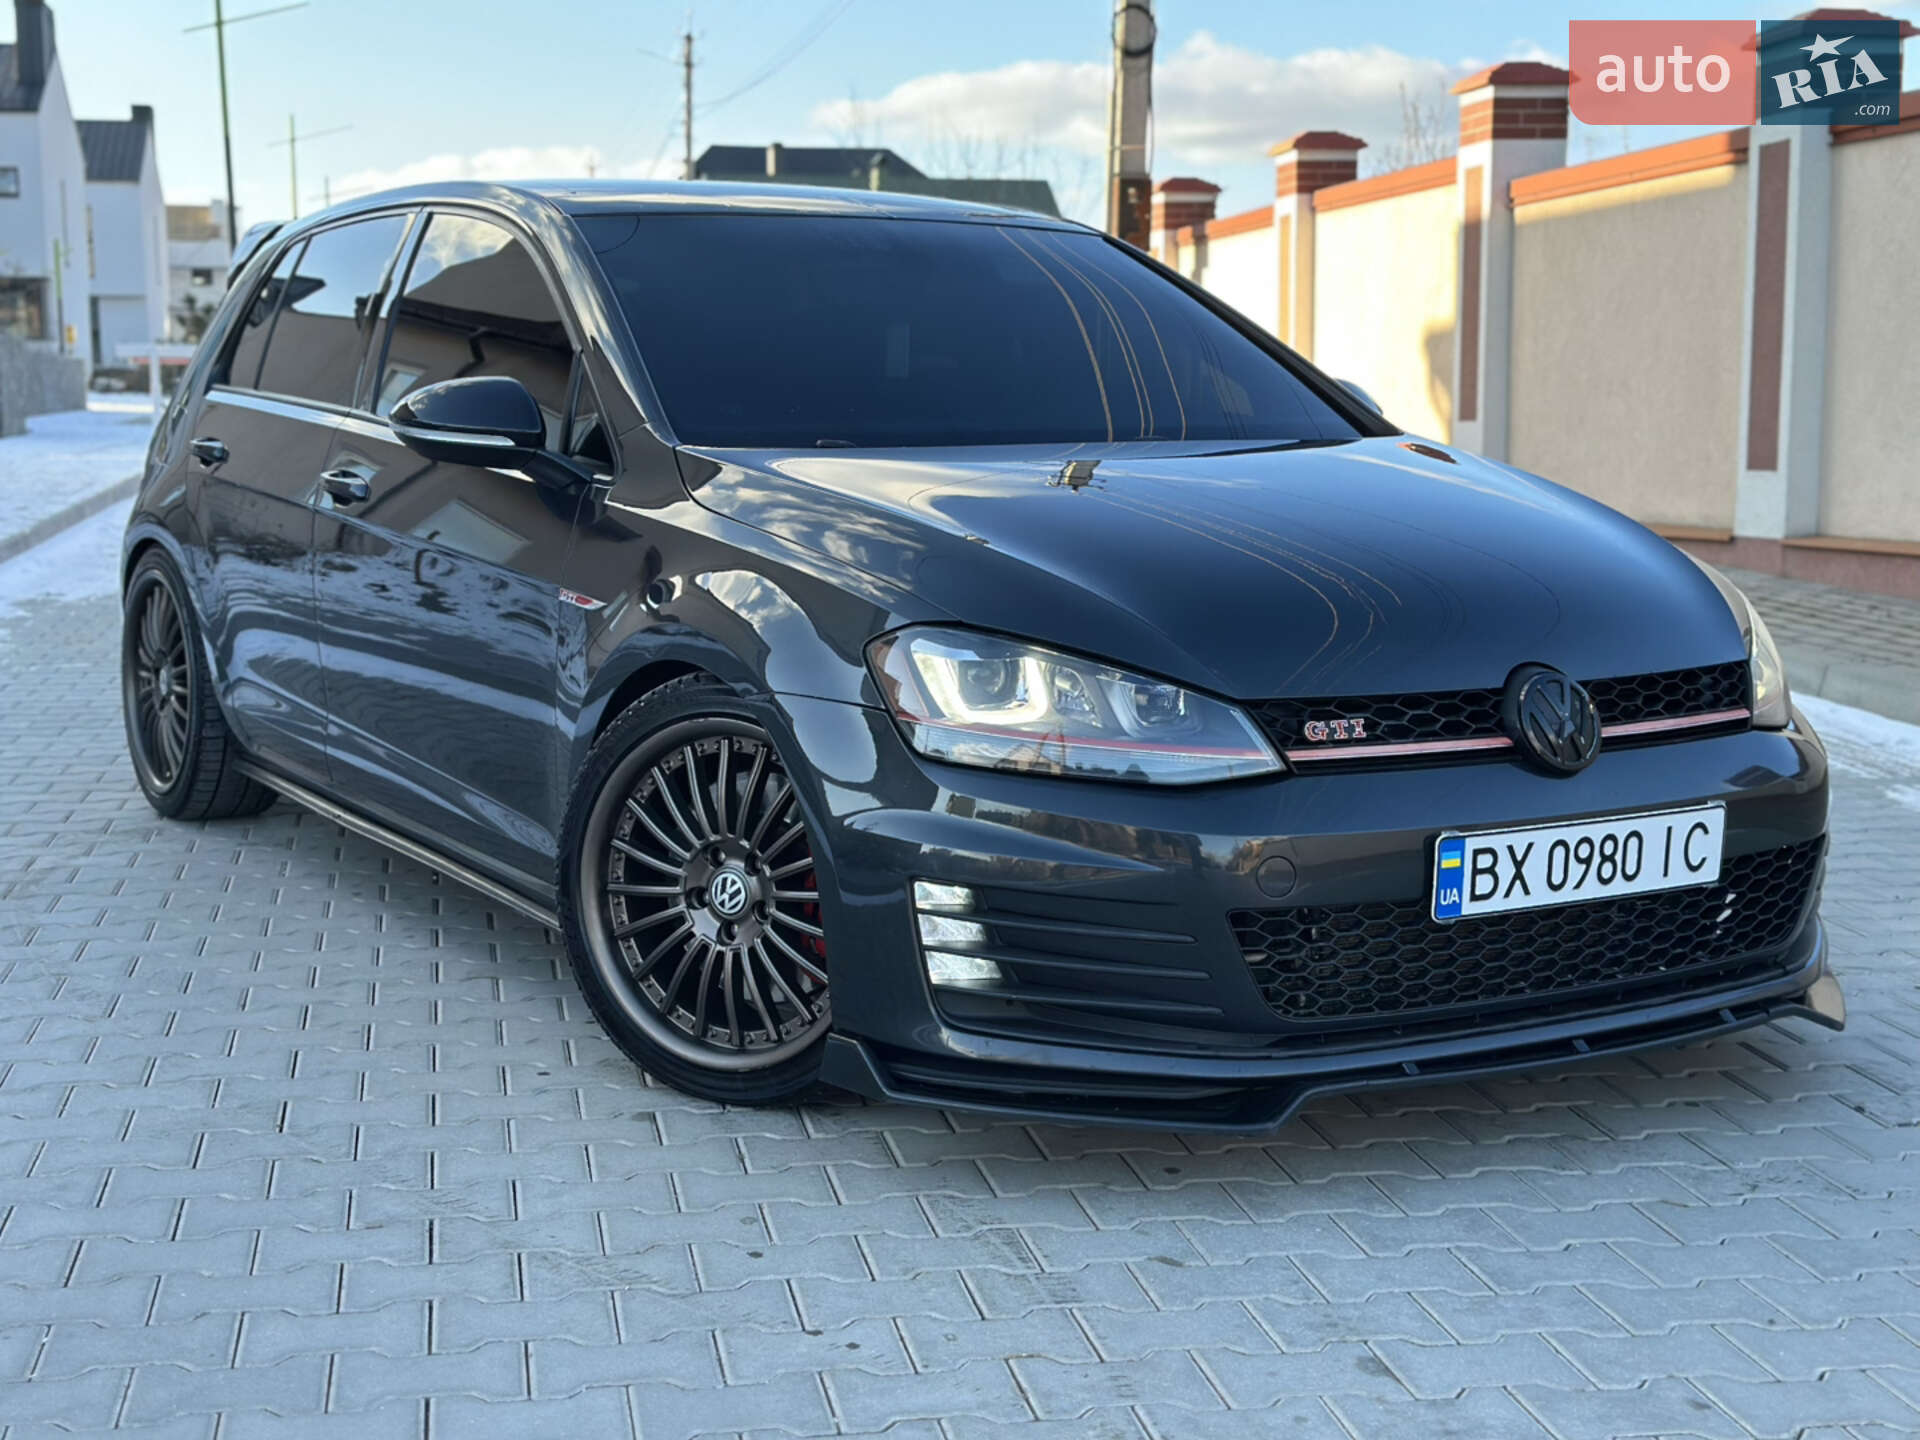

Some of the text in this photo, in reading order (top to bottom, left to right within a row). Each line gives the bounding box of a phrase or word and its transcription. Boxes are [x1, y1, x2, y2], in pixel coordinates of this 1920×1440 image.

[1304, 718, 1367, 741] GTI
[1469, 821, 1710, 903] BX 0980 IC
[1440, 887, 1460, 906] UA
